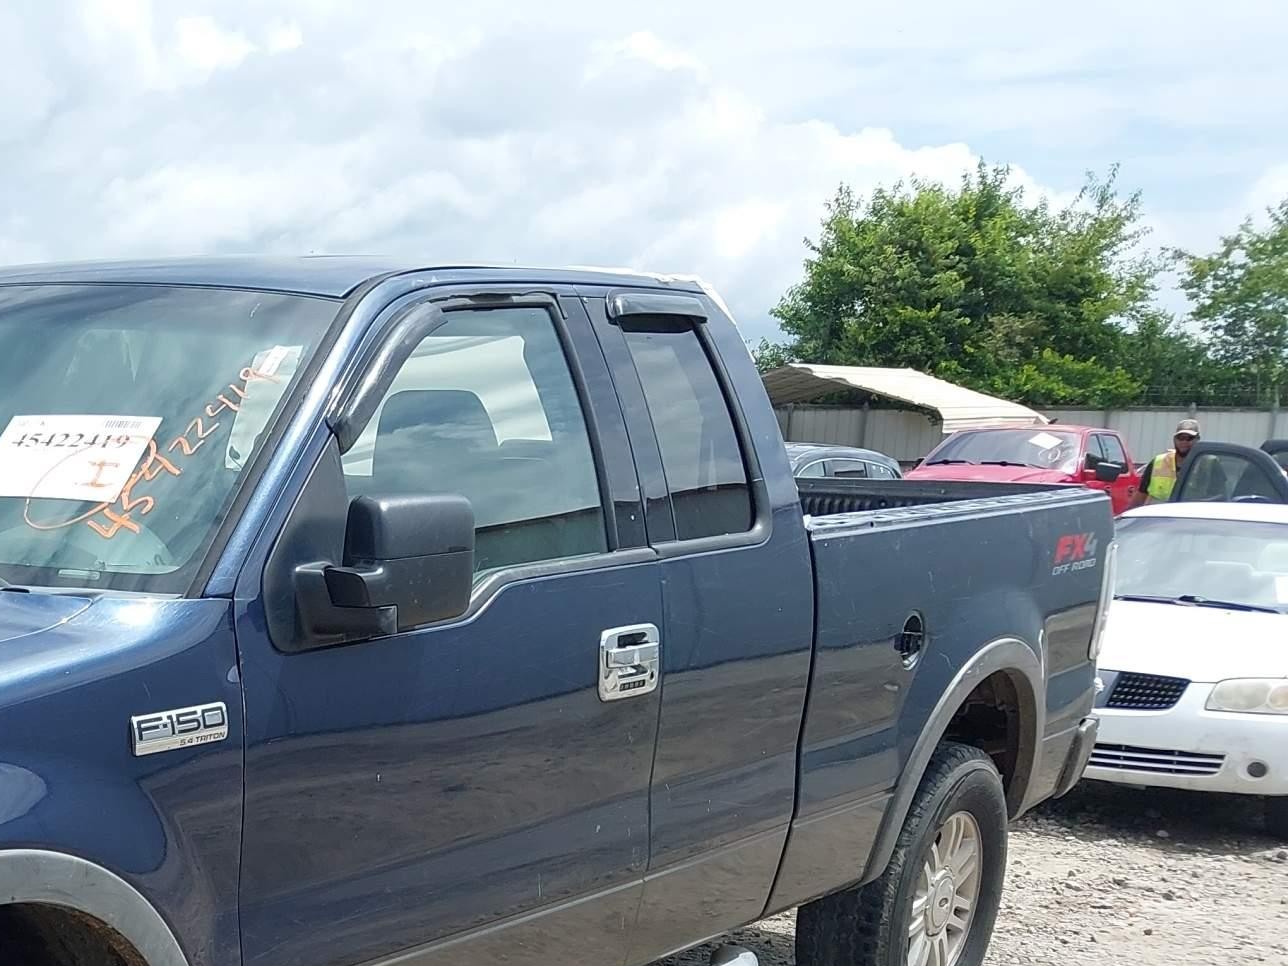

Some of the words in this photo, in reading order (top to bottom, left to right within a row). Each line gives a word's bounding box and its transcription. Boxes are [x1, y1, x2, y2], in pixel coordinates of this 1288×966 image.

[12, 432, 130, 448] 45422419
[1054, 531, 1099, 564] FX4
[1052, 563, 1070, 576] OFF
[1071, 558, 1097, 571] ROAD
[136, 706, 225, 741] F-150
[195, 731, 226, 743] TRITON
